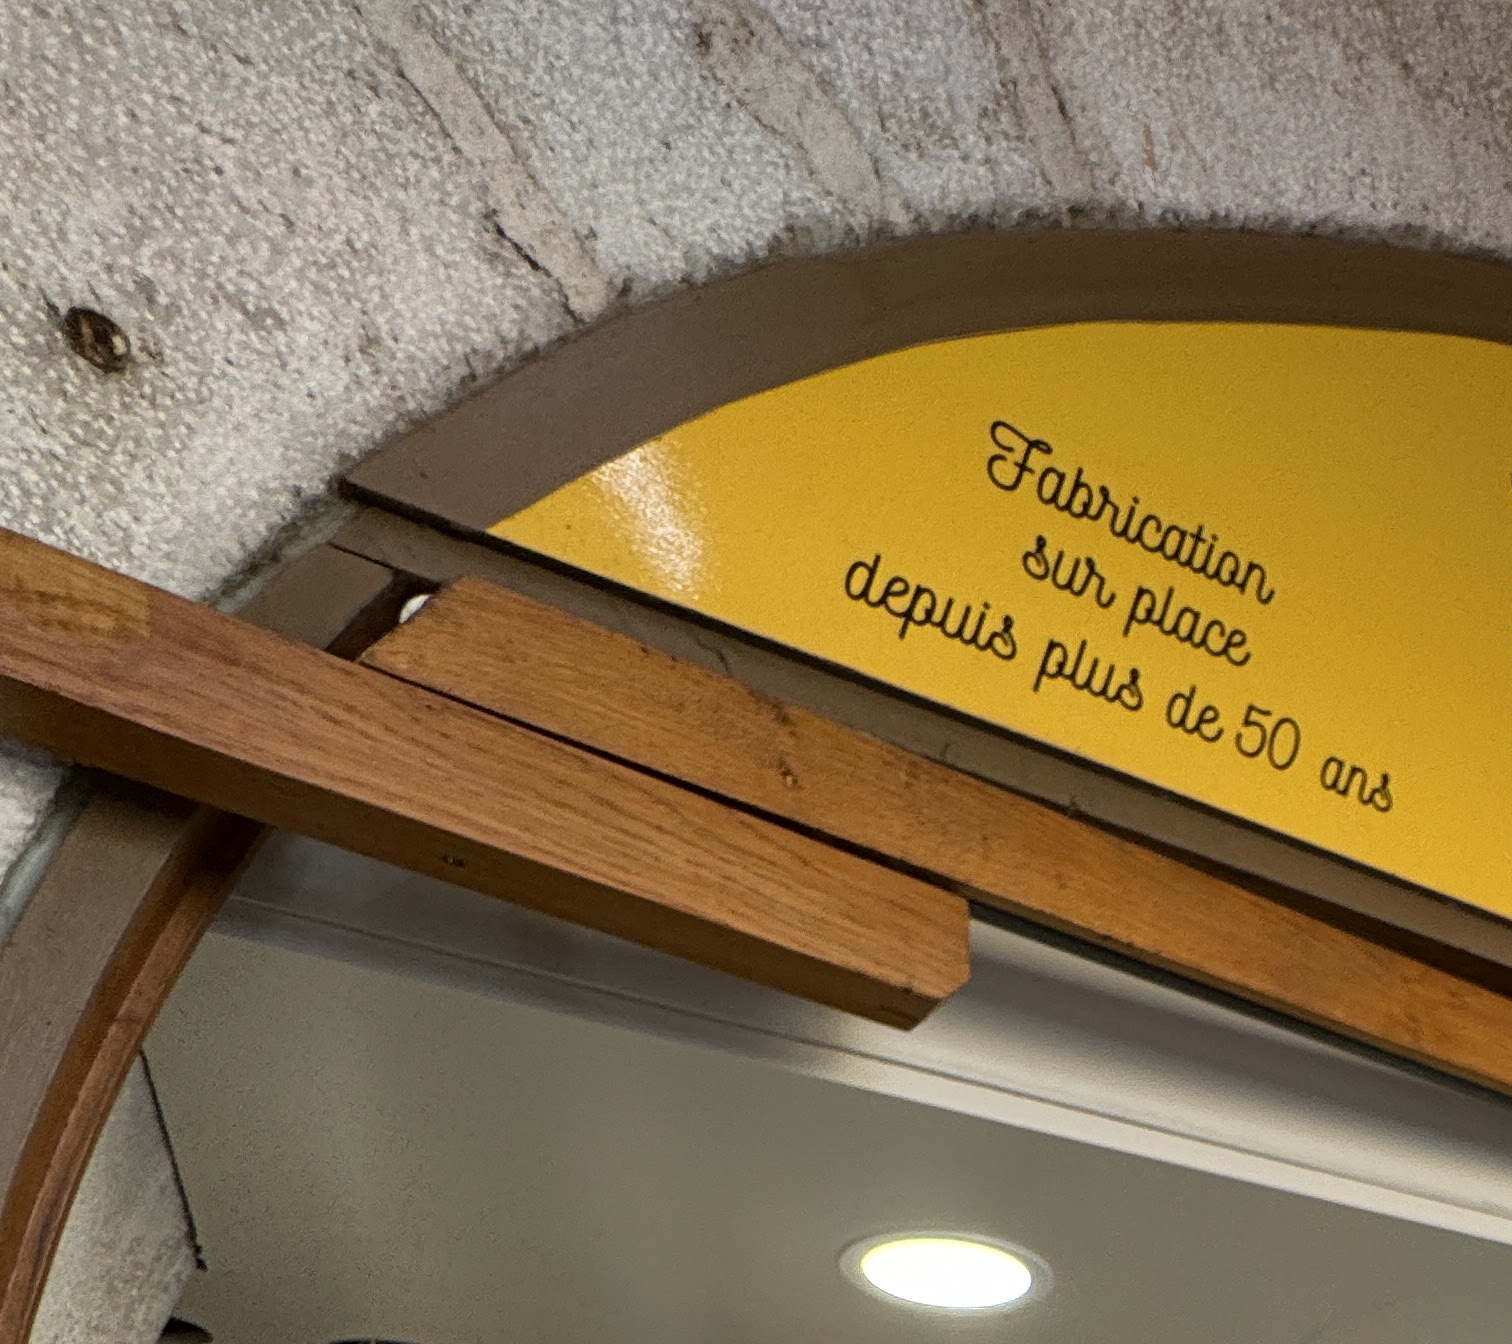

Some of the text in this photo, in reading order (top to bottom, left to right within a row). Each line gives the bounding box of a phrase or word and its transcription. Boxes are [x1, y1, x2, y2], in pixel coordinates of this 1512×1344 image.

[987, 420, 1275, 605] Fabrication
[1021, 534, 1253, 667] sur place
[844, 553, 1394, 812] depuis plus de 50 ans
